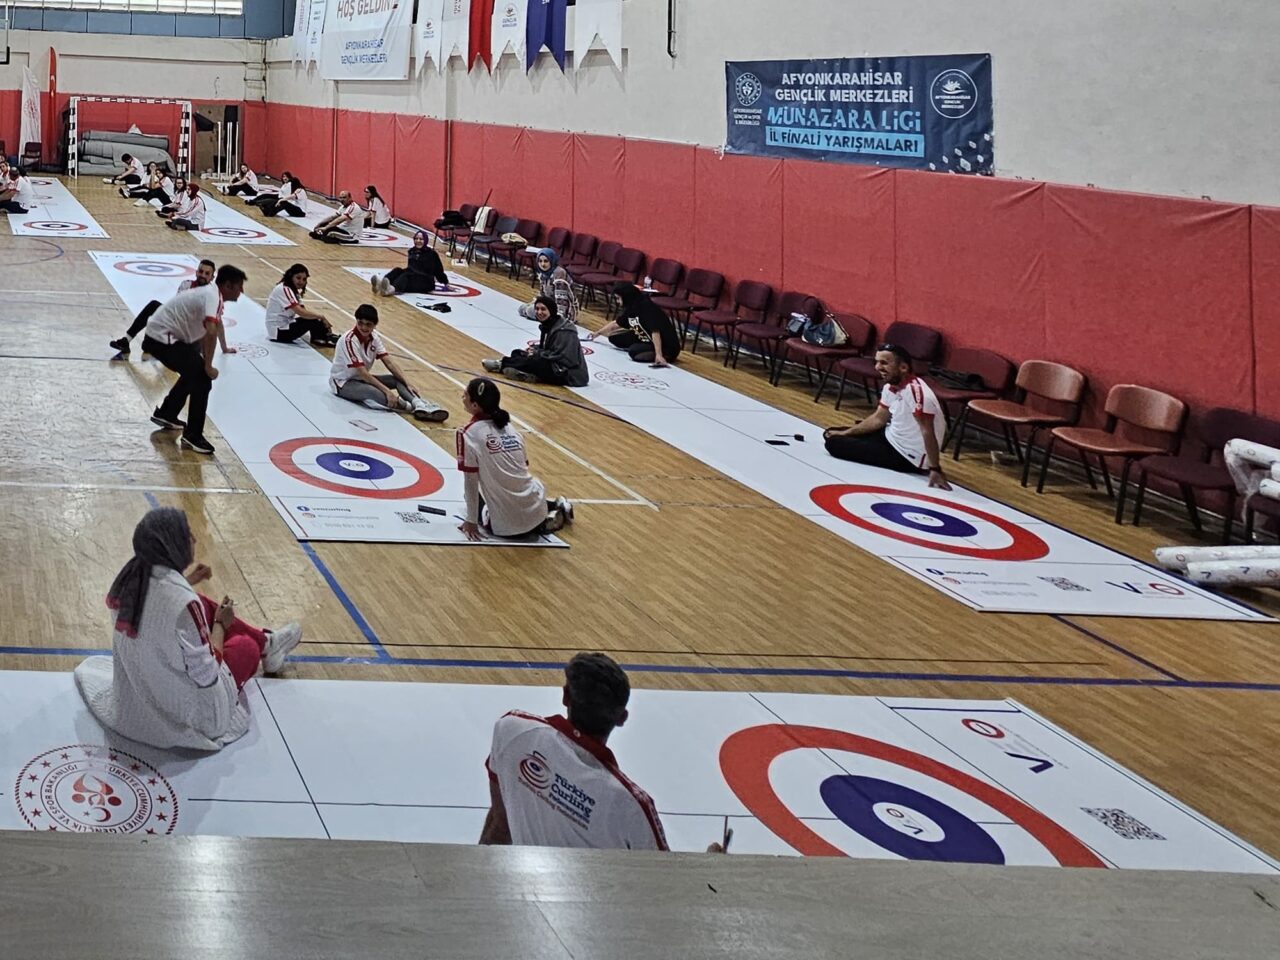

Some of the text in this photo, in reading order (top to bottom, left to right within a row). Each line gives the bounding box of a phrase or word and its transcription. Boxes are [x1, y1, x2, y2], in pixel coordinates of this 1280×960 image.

[782, 69, 903, 85] AFYONKARAHİSAR
[775, 86, 914, 104] GENÇLİK MERKEZLERİ
[767, 106, 877, 129] MÜNAZARA
[770, 128, 918, 153] İL FİNALİ YARIŞMALARI
[45, 764, 78, 793] BAKANLIĞI
[109, 766, 140, 787] ÜRKİYE
[551, 784, 593, 818] Curling
[554, 773, 596, 807] Türkiye
[45, 795, 60, 815] SPOR
